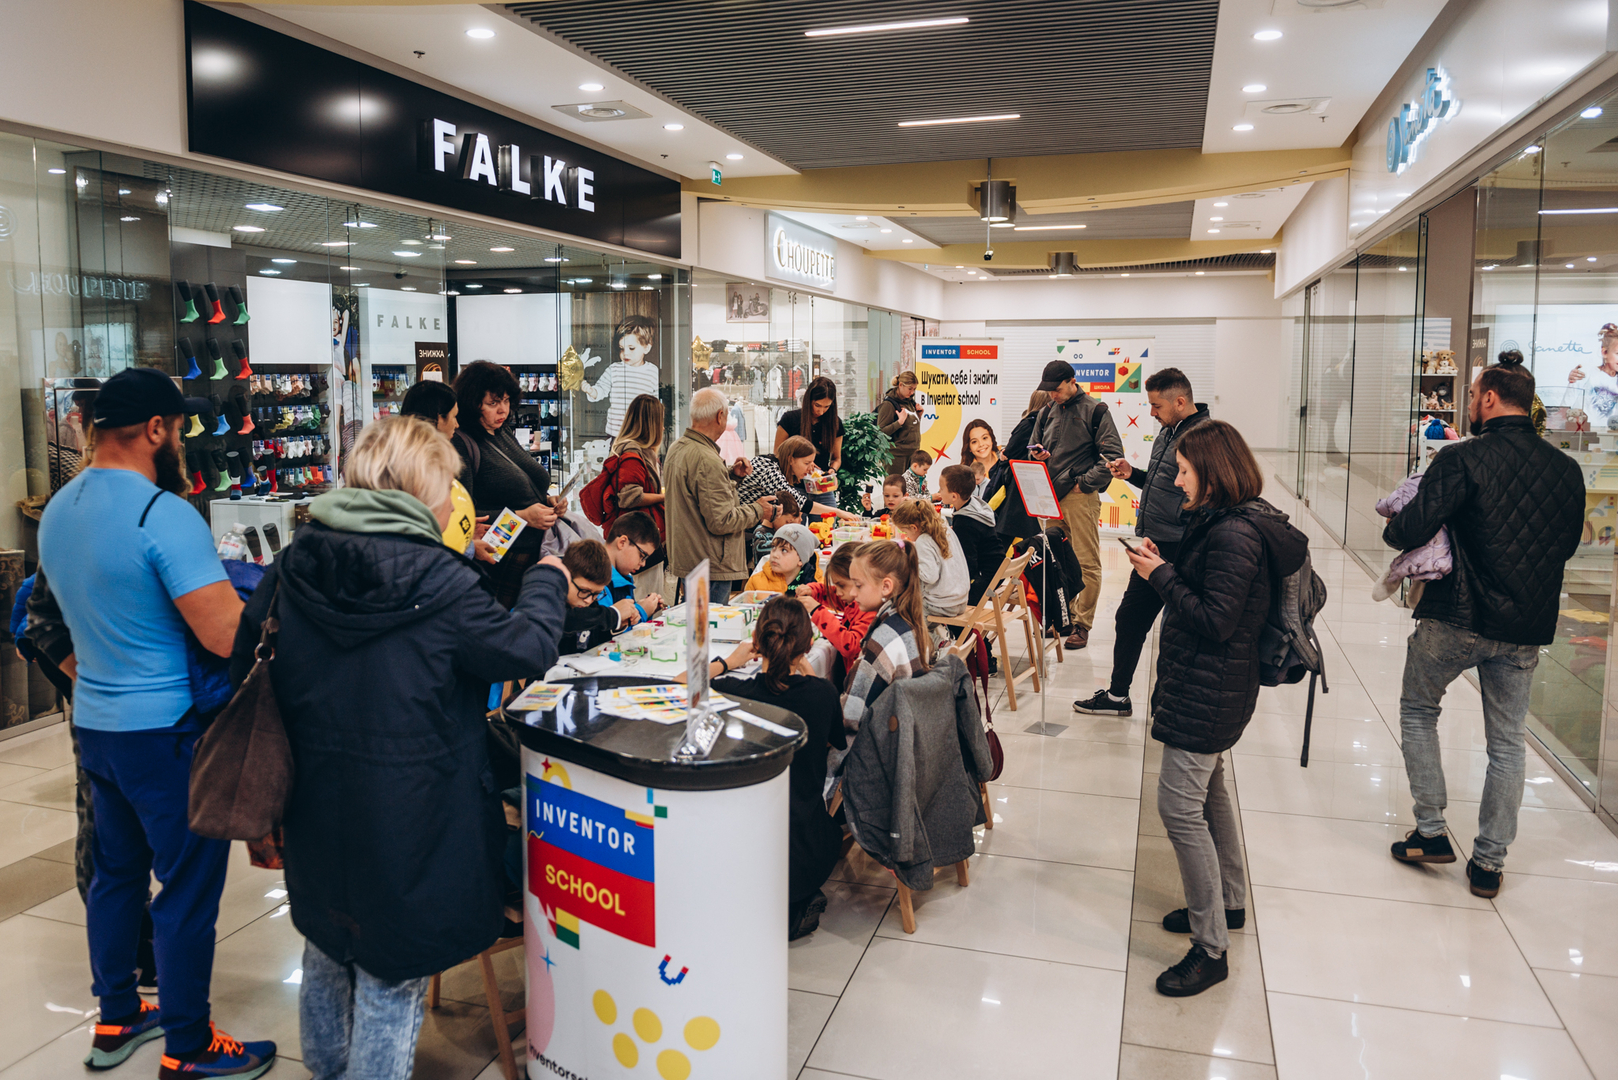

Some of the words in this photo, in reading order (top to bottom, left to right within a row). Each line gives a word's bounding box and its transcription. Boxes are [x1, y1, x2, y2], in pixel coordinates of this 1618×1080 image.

[433, 118, 595, 212] FALKE
[776, 229, 835, 280] CHOUPETTE
[377, 314, 441, 330] FALKE
[418, 349, 445, 358] ЗНИЖКА
[921, 370, 949, 389] Шукати
[950, 370, 968, 385] себе
[973, 369, 998, 385] знайти
[920, 394, 926, 405] в
[926, 392, 956, 406] Inventor
[957, 390, 981, 406] school
[536, 799, 636, 855] INVENTOR
[545, 863, 626, 917] SCHOOL
